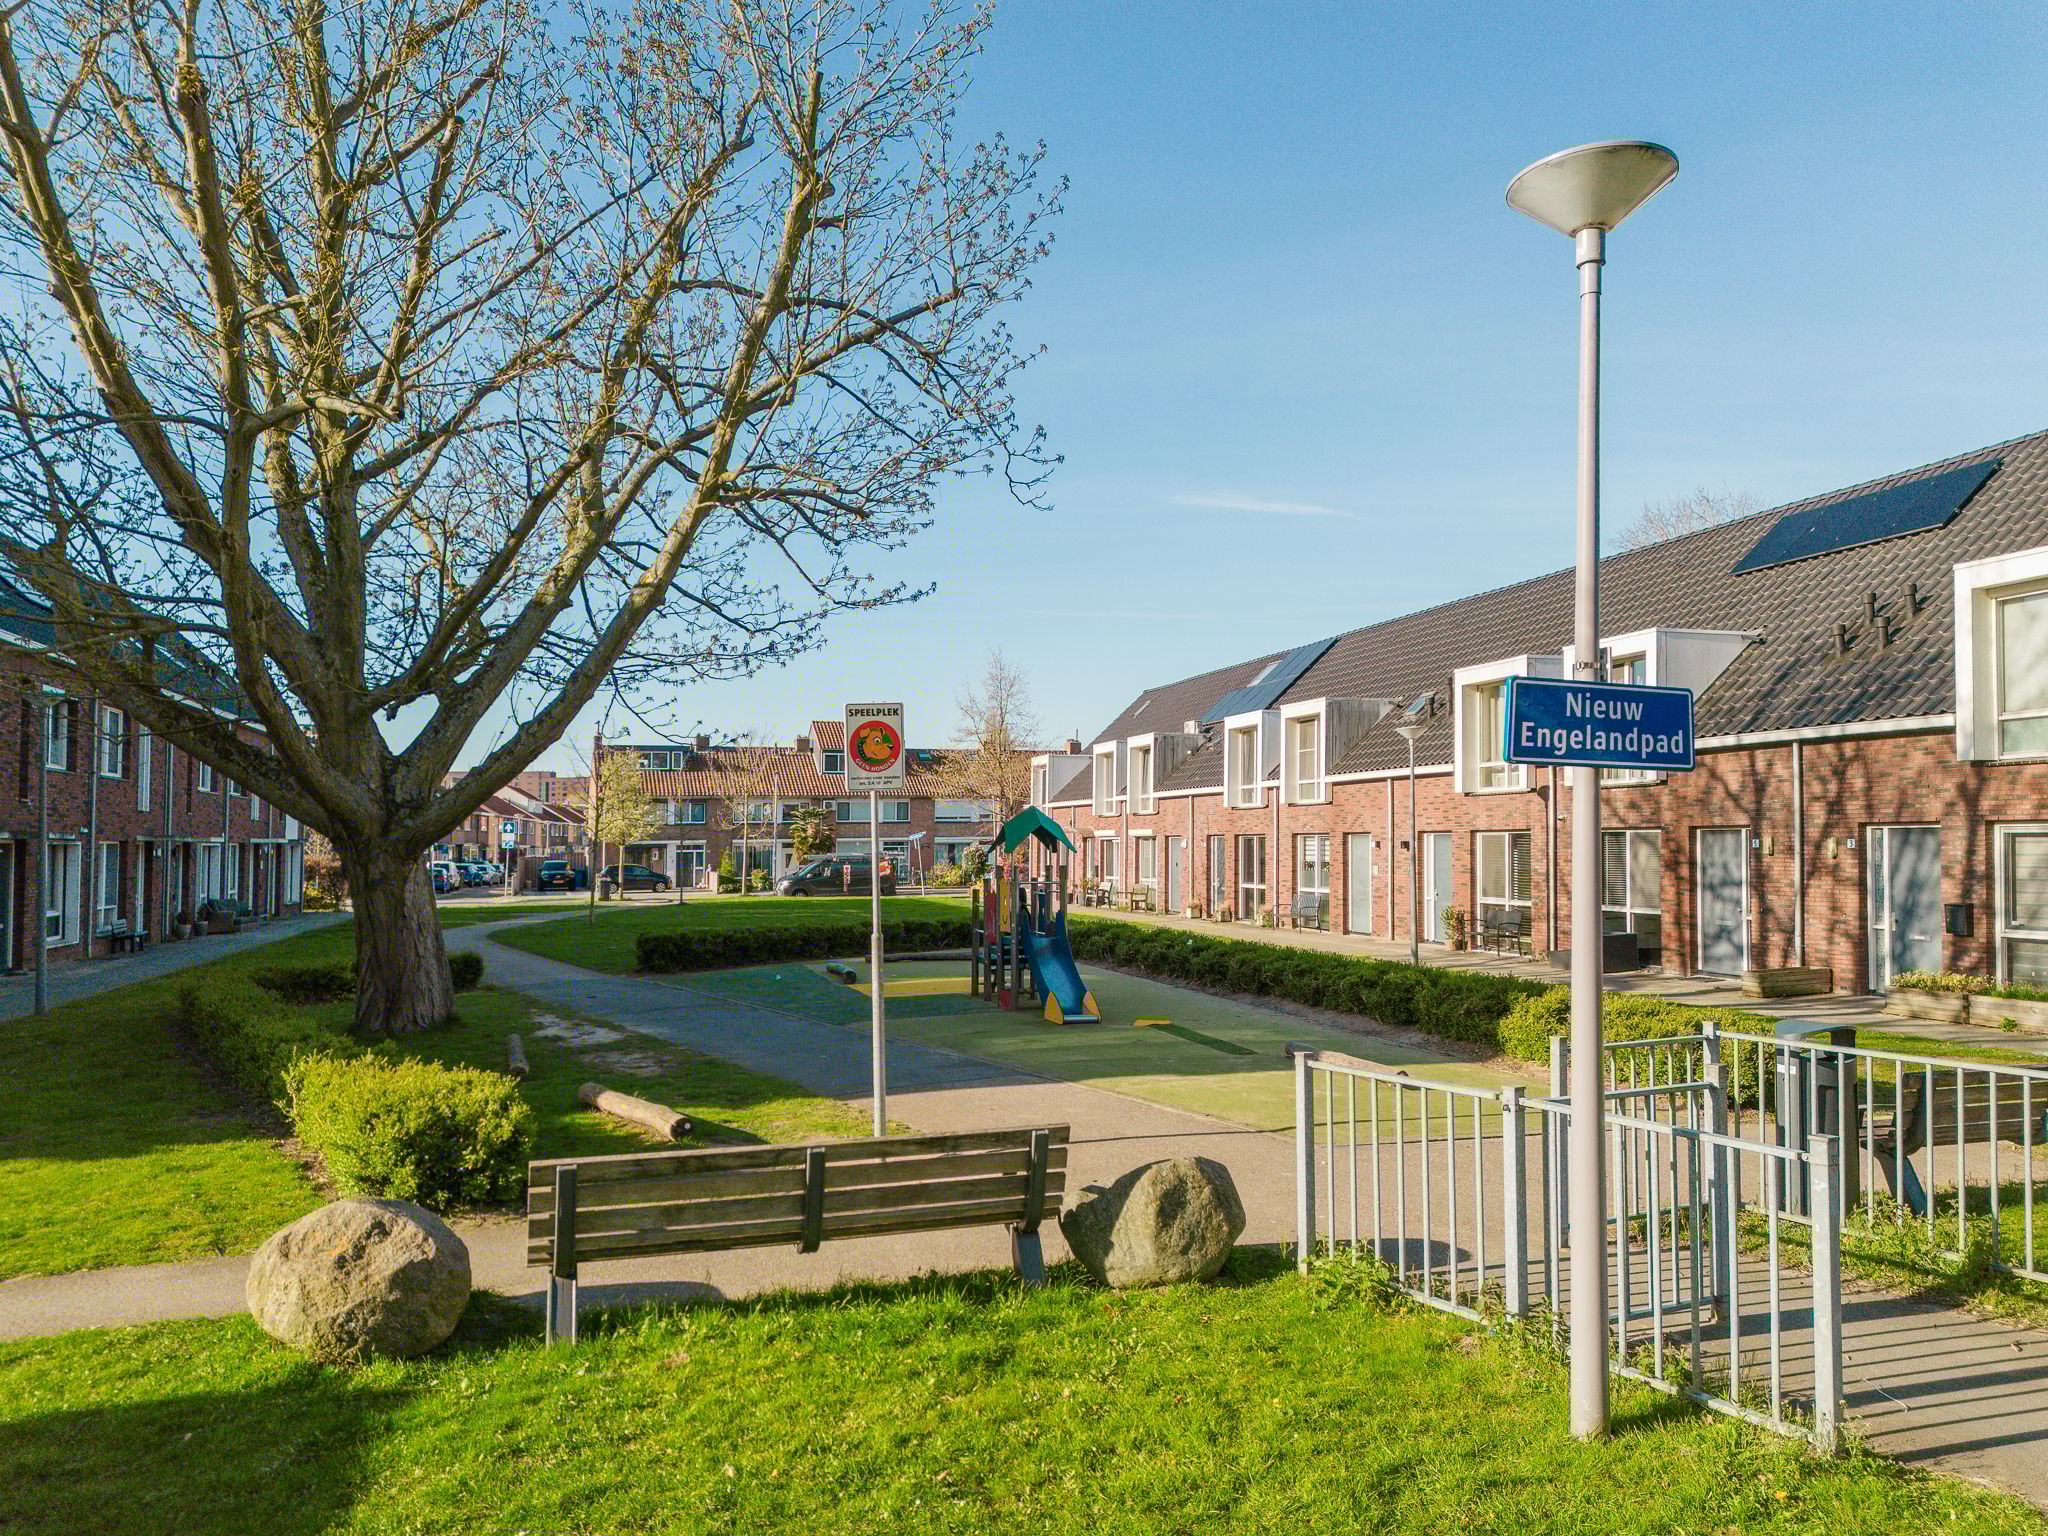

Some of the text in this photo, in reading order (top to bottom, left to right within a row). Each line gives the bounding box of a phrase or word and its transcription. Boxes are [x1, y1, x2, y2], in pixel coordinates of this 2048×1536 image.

[848, 708, 899, 717] SPEELPLEK
[1566, 692, 1643, 721] Nieuw
[1521, 722, 1684, 759] Engelandpad
[856, 757, 896, 772] GEEN HONDEN
